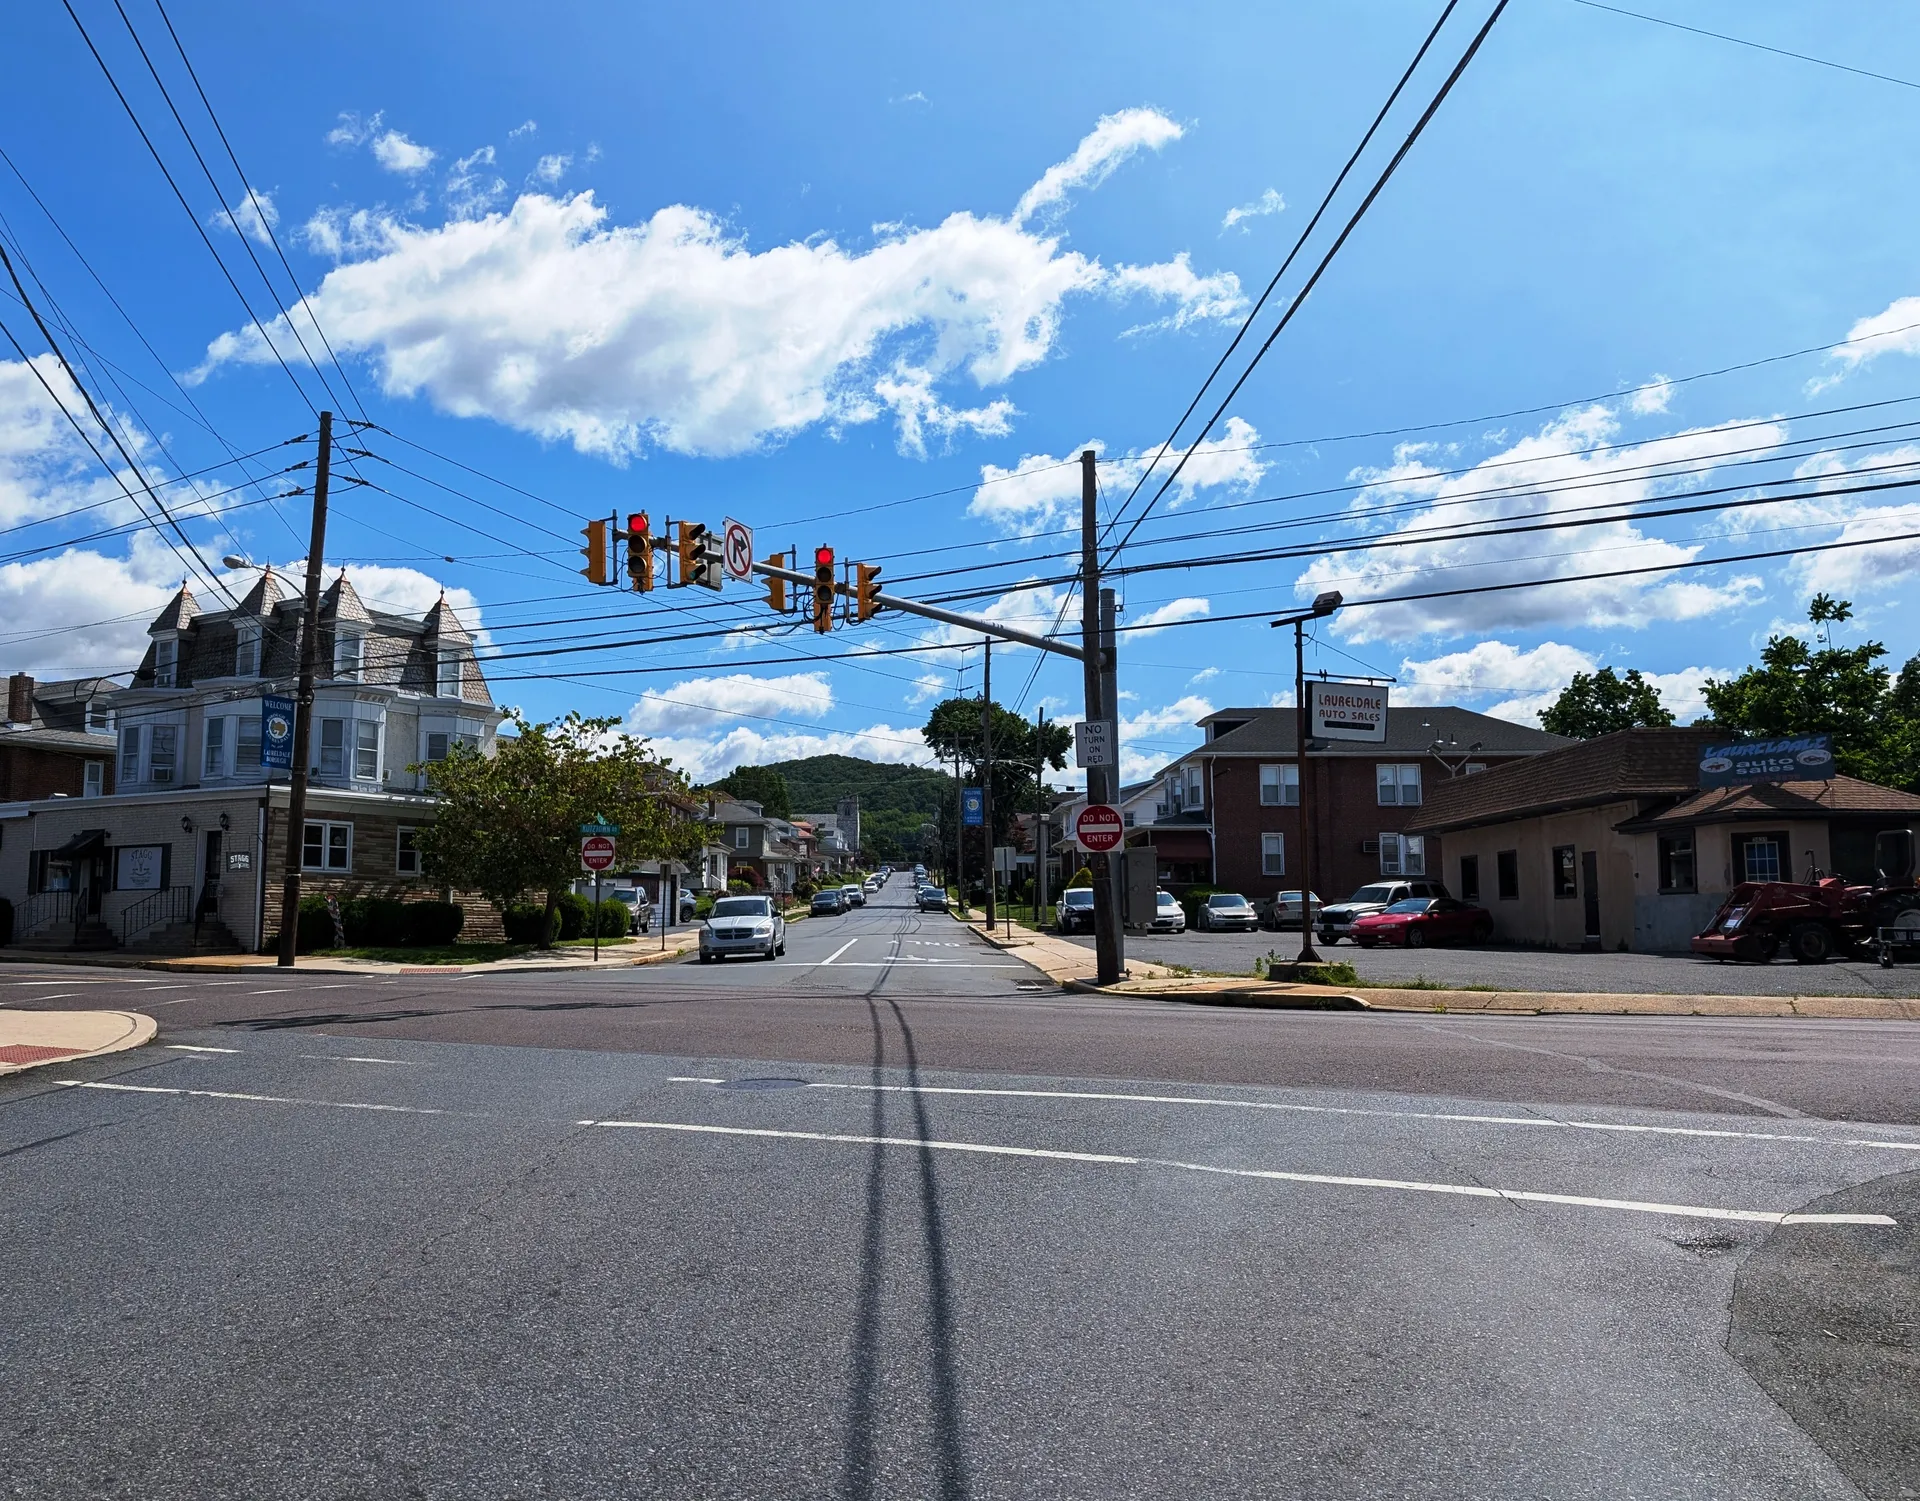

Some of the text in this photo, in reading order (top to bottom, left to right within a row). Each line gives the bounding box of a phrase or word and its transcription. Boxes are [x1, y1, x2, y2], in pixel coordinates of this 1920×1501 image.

[264, 700, 293, 711] WELCOME
[1318, 694, 1381, 709] LAURELDALE
[1319, 709, 1380, 722] AUTO SALES
[1085, 725, 1102, 734] NO
[1084, 736, 1105, 744] TURN
[1704, 736, 1827, 759] LAURELDALE
[263, 749, 291, 758] LAURELDALE
[266, 756, 287, 764] BOROUGH
[1087, 755, 1103, 763] RED
[1736, 758, 1794, 768] auto
[1736, 764, 1795, 775] sales
[1099, 813, 1115, 822] NOT
[1087, 834, 1113, 842] ENTER
[130, 849, 153, 861] STAGG
[230, 854, 250, 863] STAGG
